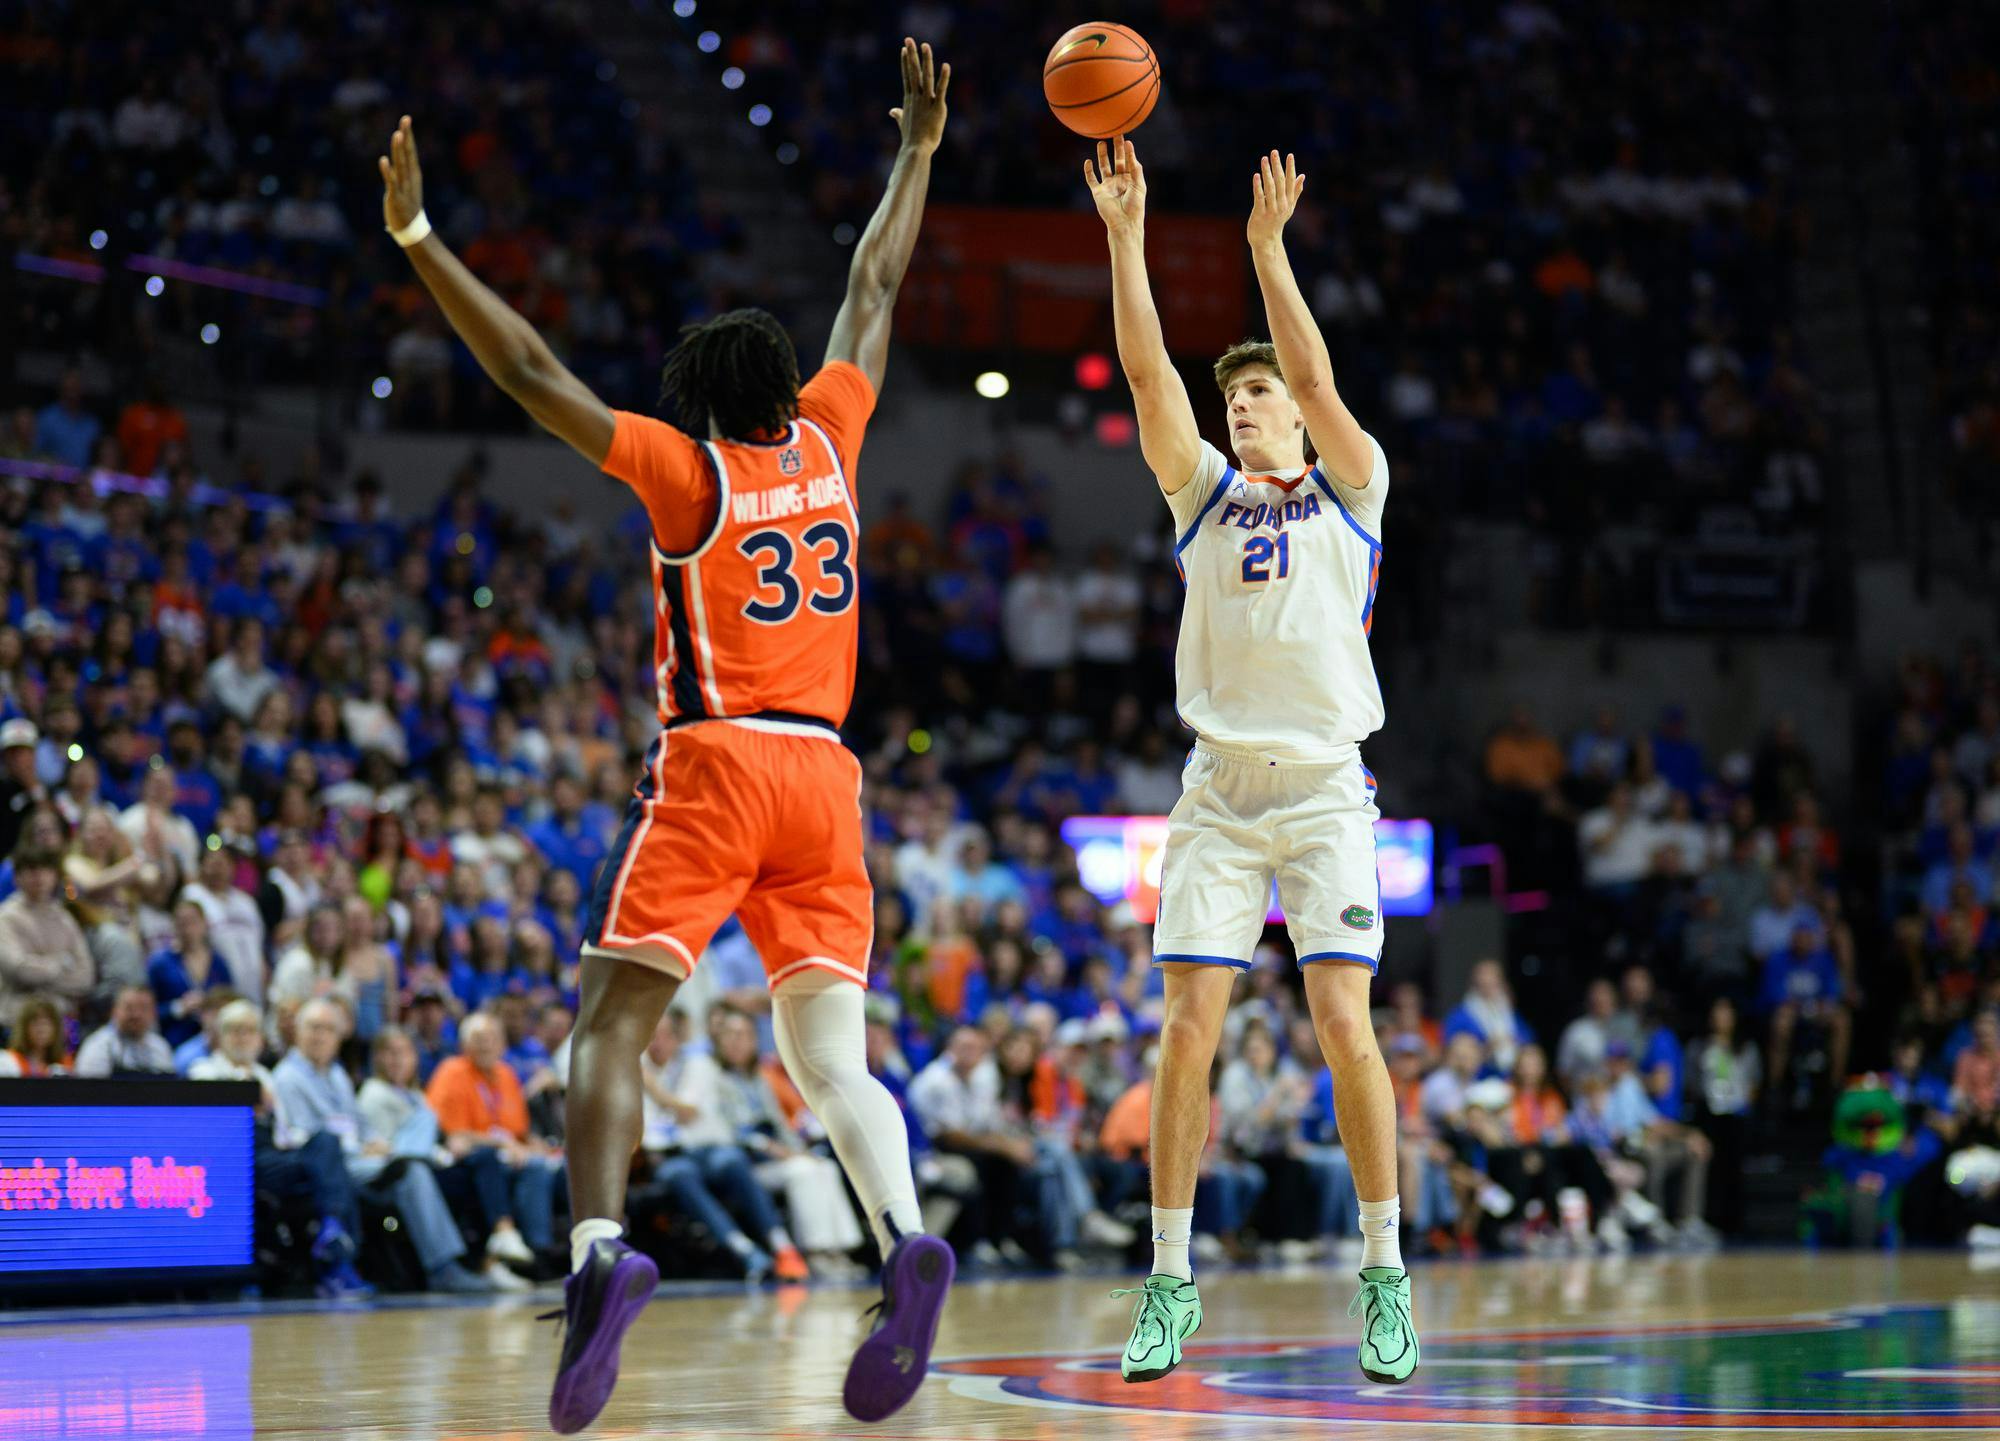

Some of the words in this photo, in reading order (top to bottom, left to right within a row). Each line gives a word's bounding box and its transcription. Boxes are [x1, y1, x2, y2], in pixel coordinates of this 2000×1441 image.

[731, 473, 844, 524] WILLIAMS-ADAS
[1216, 492, 1322, 532] FLORIDA
[736, 518, 857, 626] 33
[1241, 530, 1289, 583] 21
